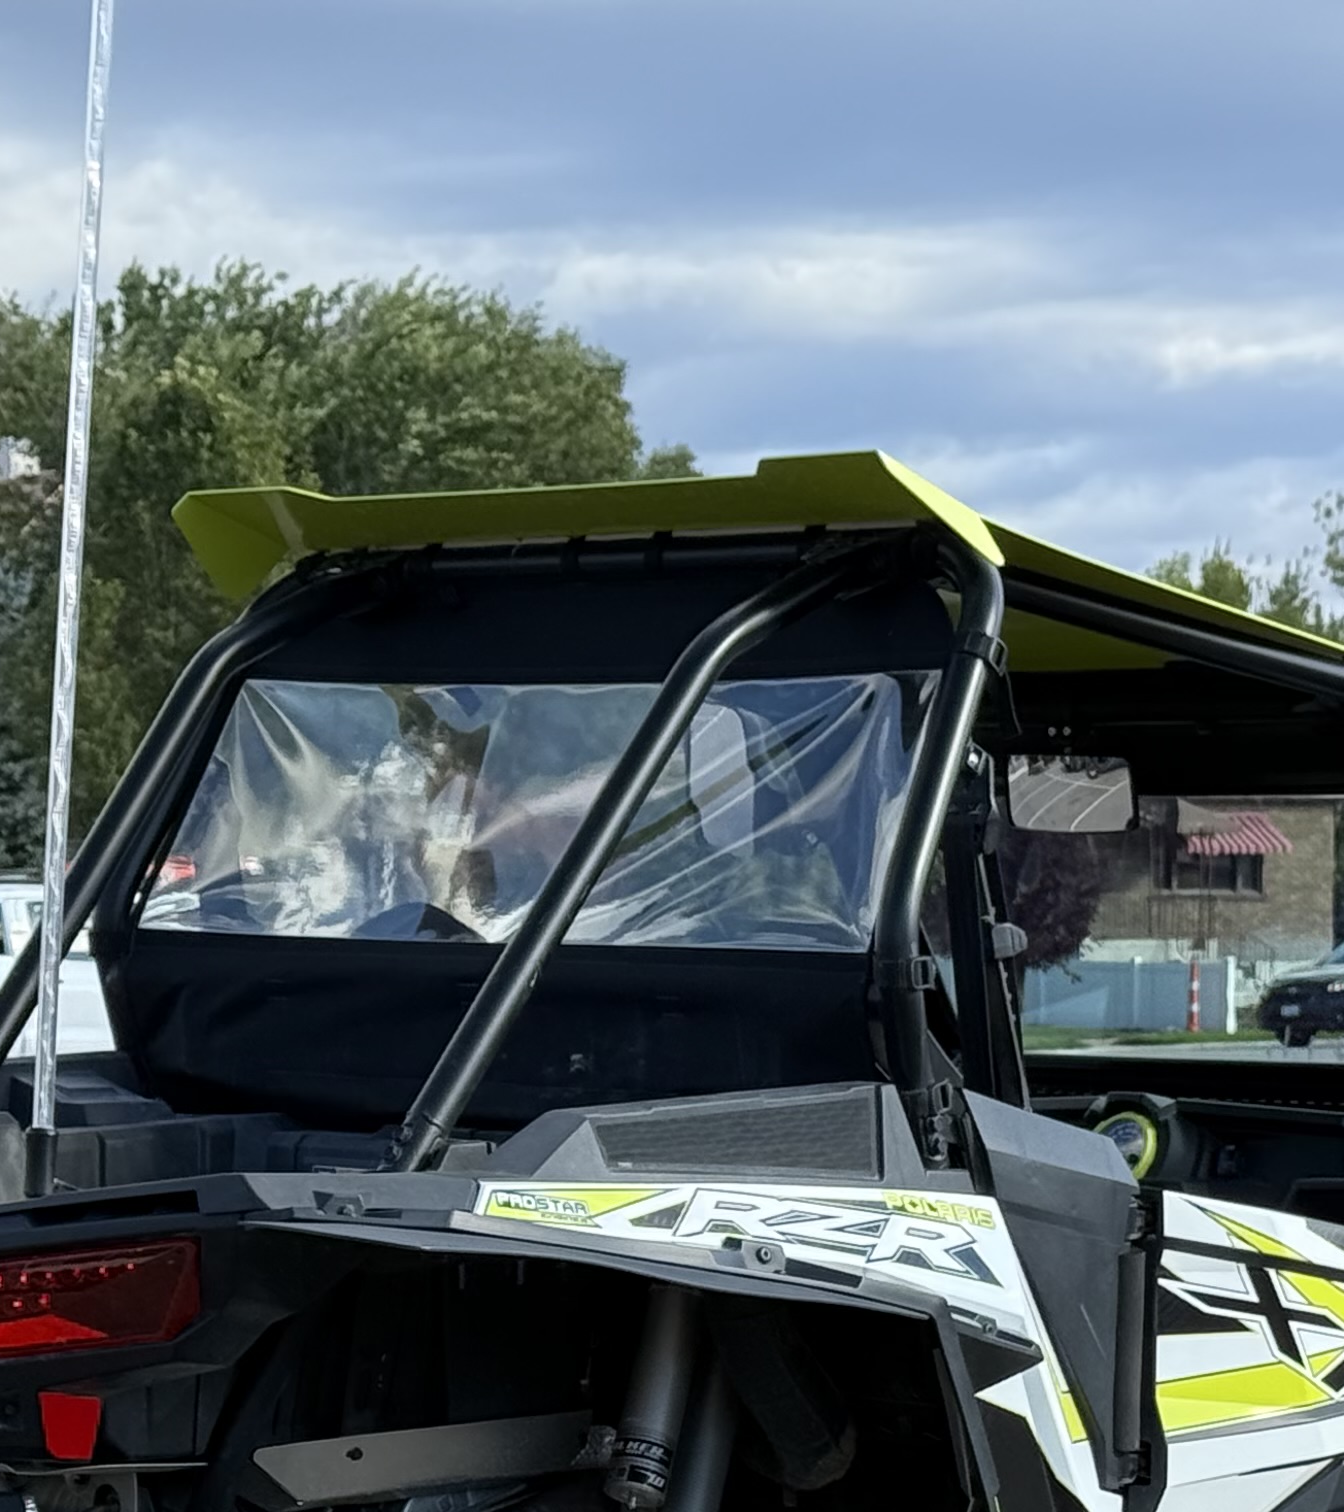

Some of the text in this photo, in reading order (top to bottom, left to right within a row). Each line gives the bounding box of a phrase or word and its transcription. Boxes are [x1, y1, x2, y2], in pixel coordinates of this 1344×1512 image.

[495, 1192, 589, 1216] PROSTAR
[881, 1191, 996, 1230] POLARIS
[673, 1188, 1004, 1288] RZR
